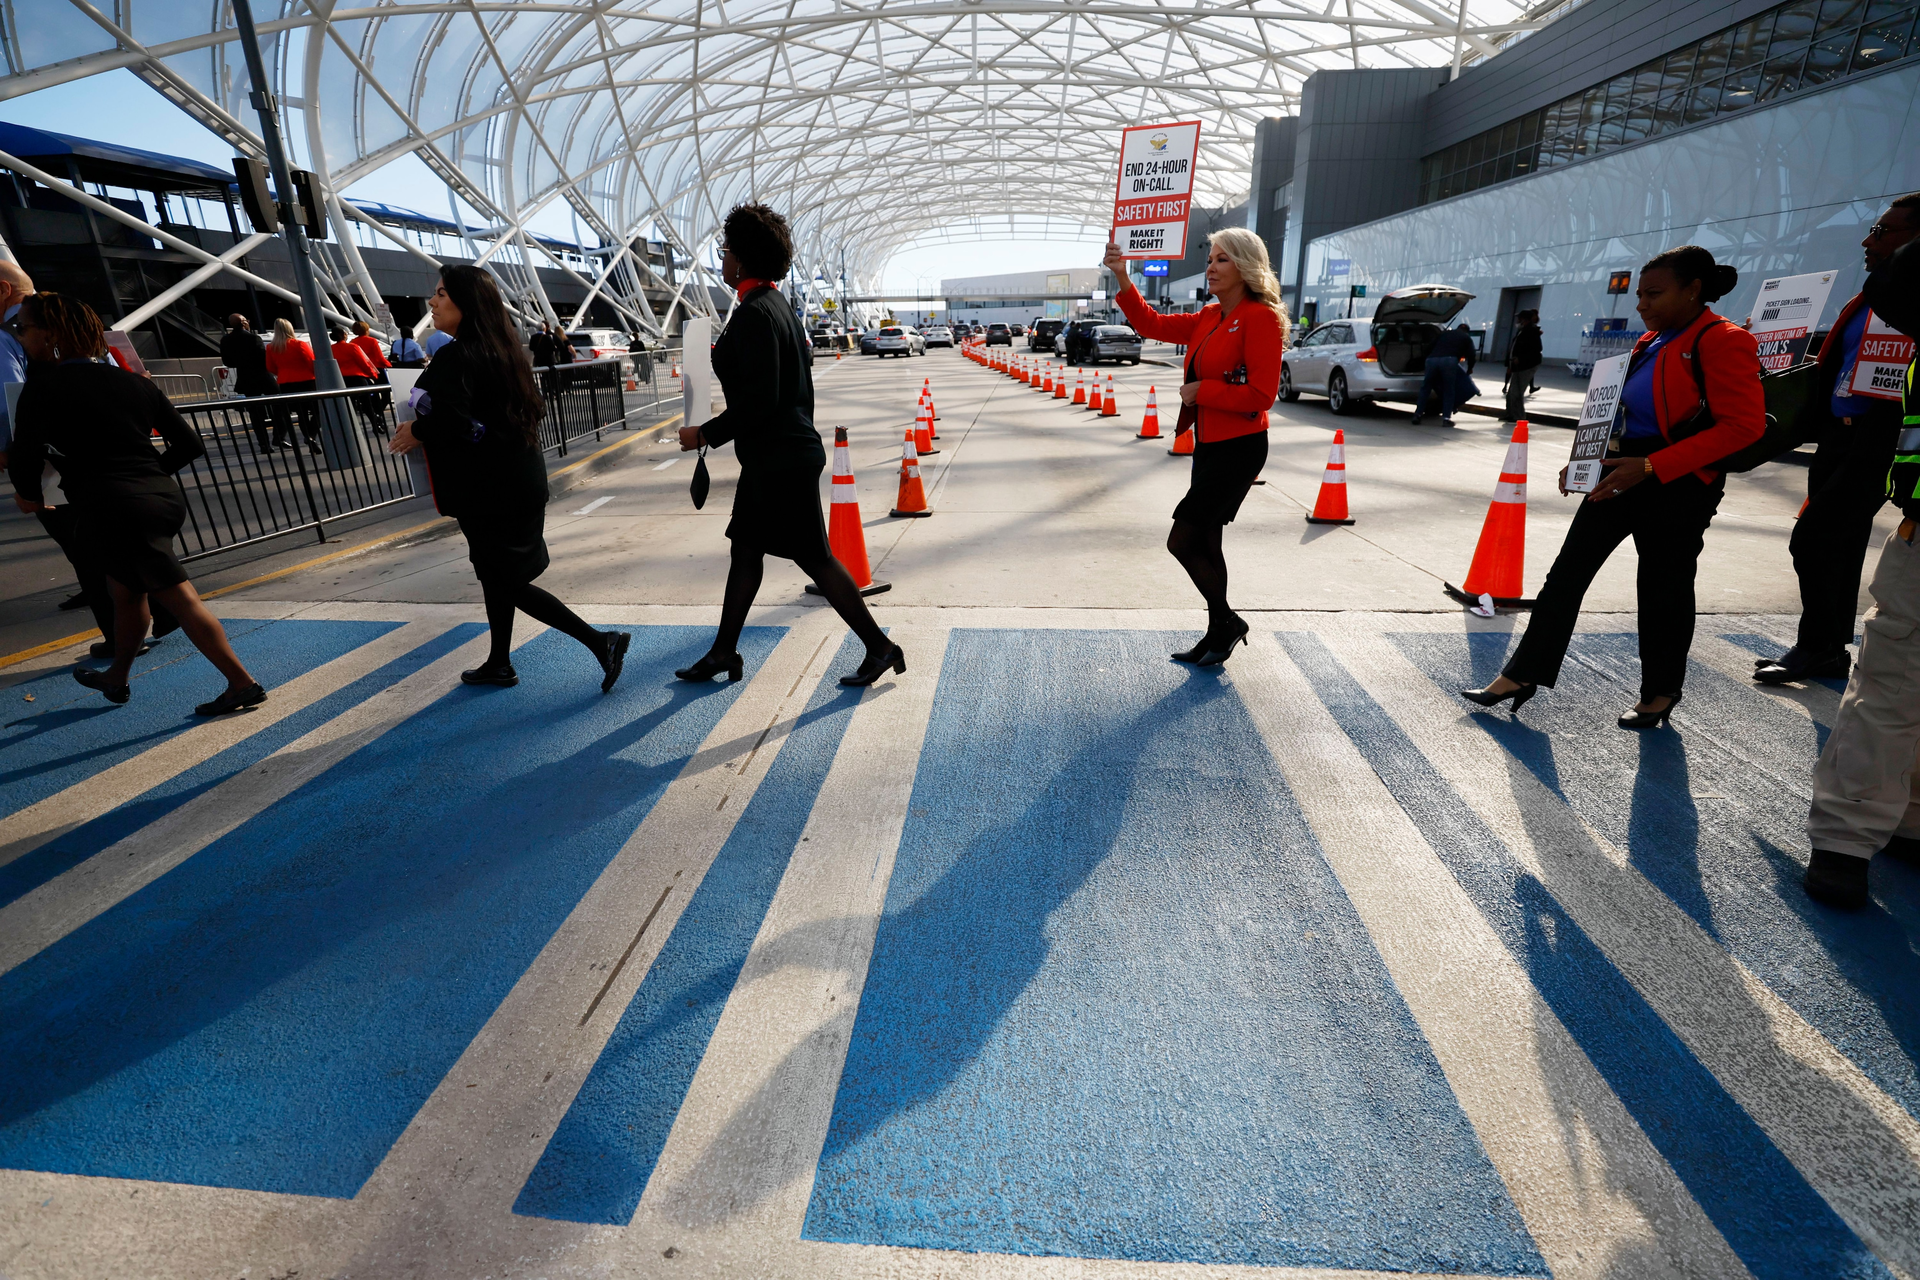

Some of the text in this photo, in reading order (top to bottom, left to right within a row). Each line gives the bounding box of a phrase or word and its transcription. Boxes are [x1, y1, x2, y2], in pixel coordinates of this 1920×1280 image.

[1125, 159, 1188, 177] END 24-HOUR
[1133, 177, 1175, 193] ON-CALL.
[1117, 200, 1187, 221] SAFETY FIRST
[1130, 229, 1165, 238] MAKE IT
[1129, 239, 1164, 249] RIGHT!
[1765, 300, 1780, 308] PICKET
[1774, 329, 1796, 340] VICTIM
[1796, 328, 1805, 337] OF
[1756, 339, 1790, 356] SWA'S
[1863, 340, 1907, 357] SAFETY
[1874, 366, 1903, 377] MAKE
[1588, 384, 1618, 402] NO FOOD
[1585, 402, 1612, 419] NO REST
[1577, 426, 1608, 442] I CAN'T BE
[1575, 442, 1602, 457] MY BEST
